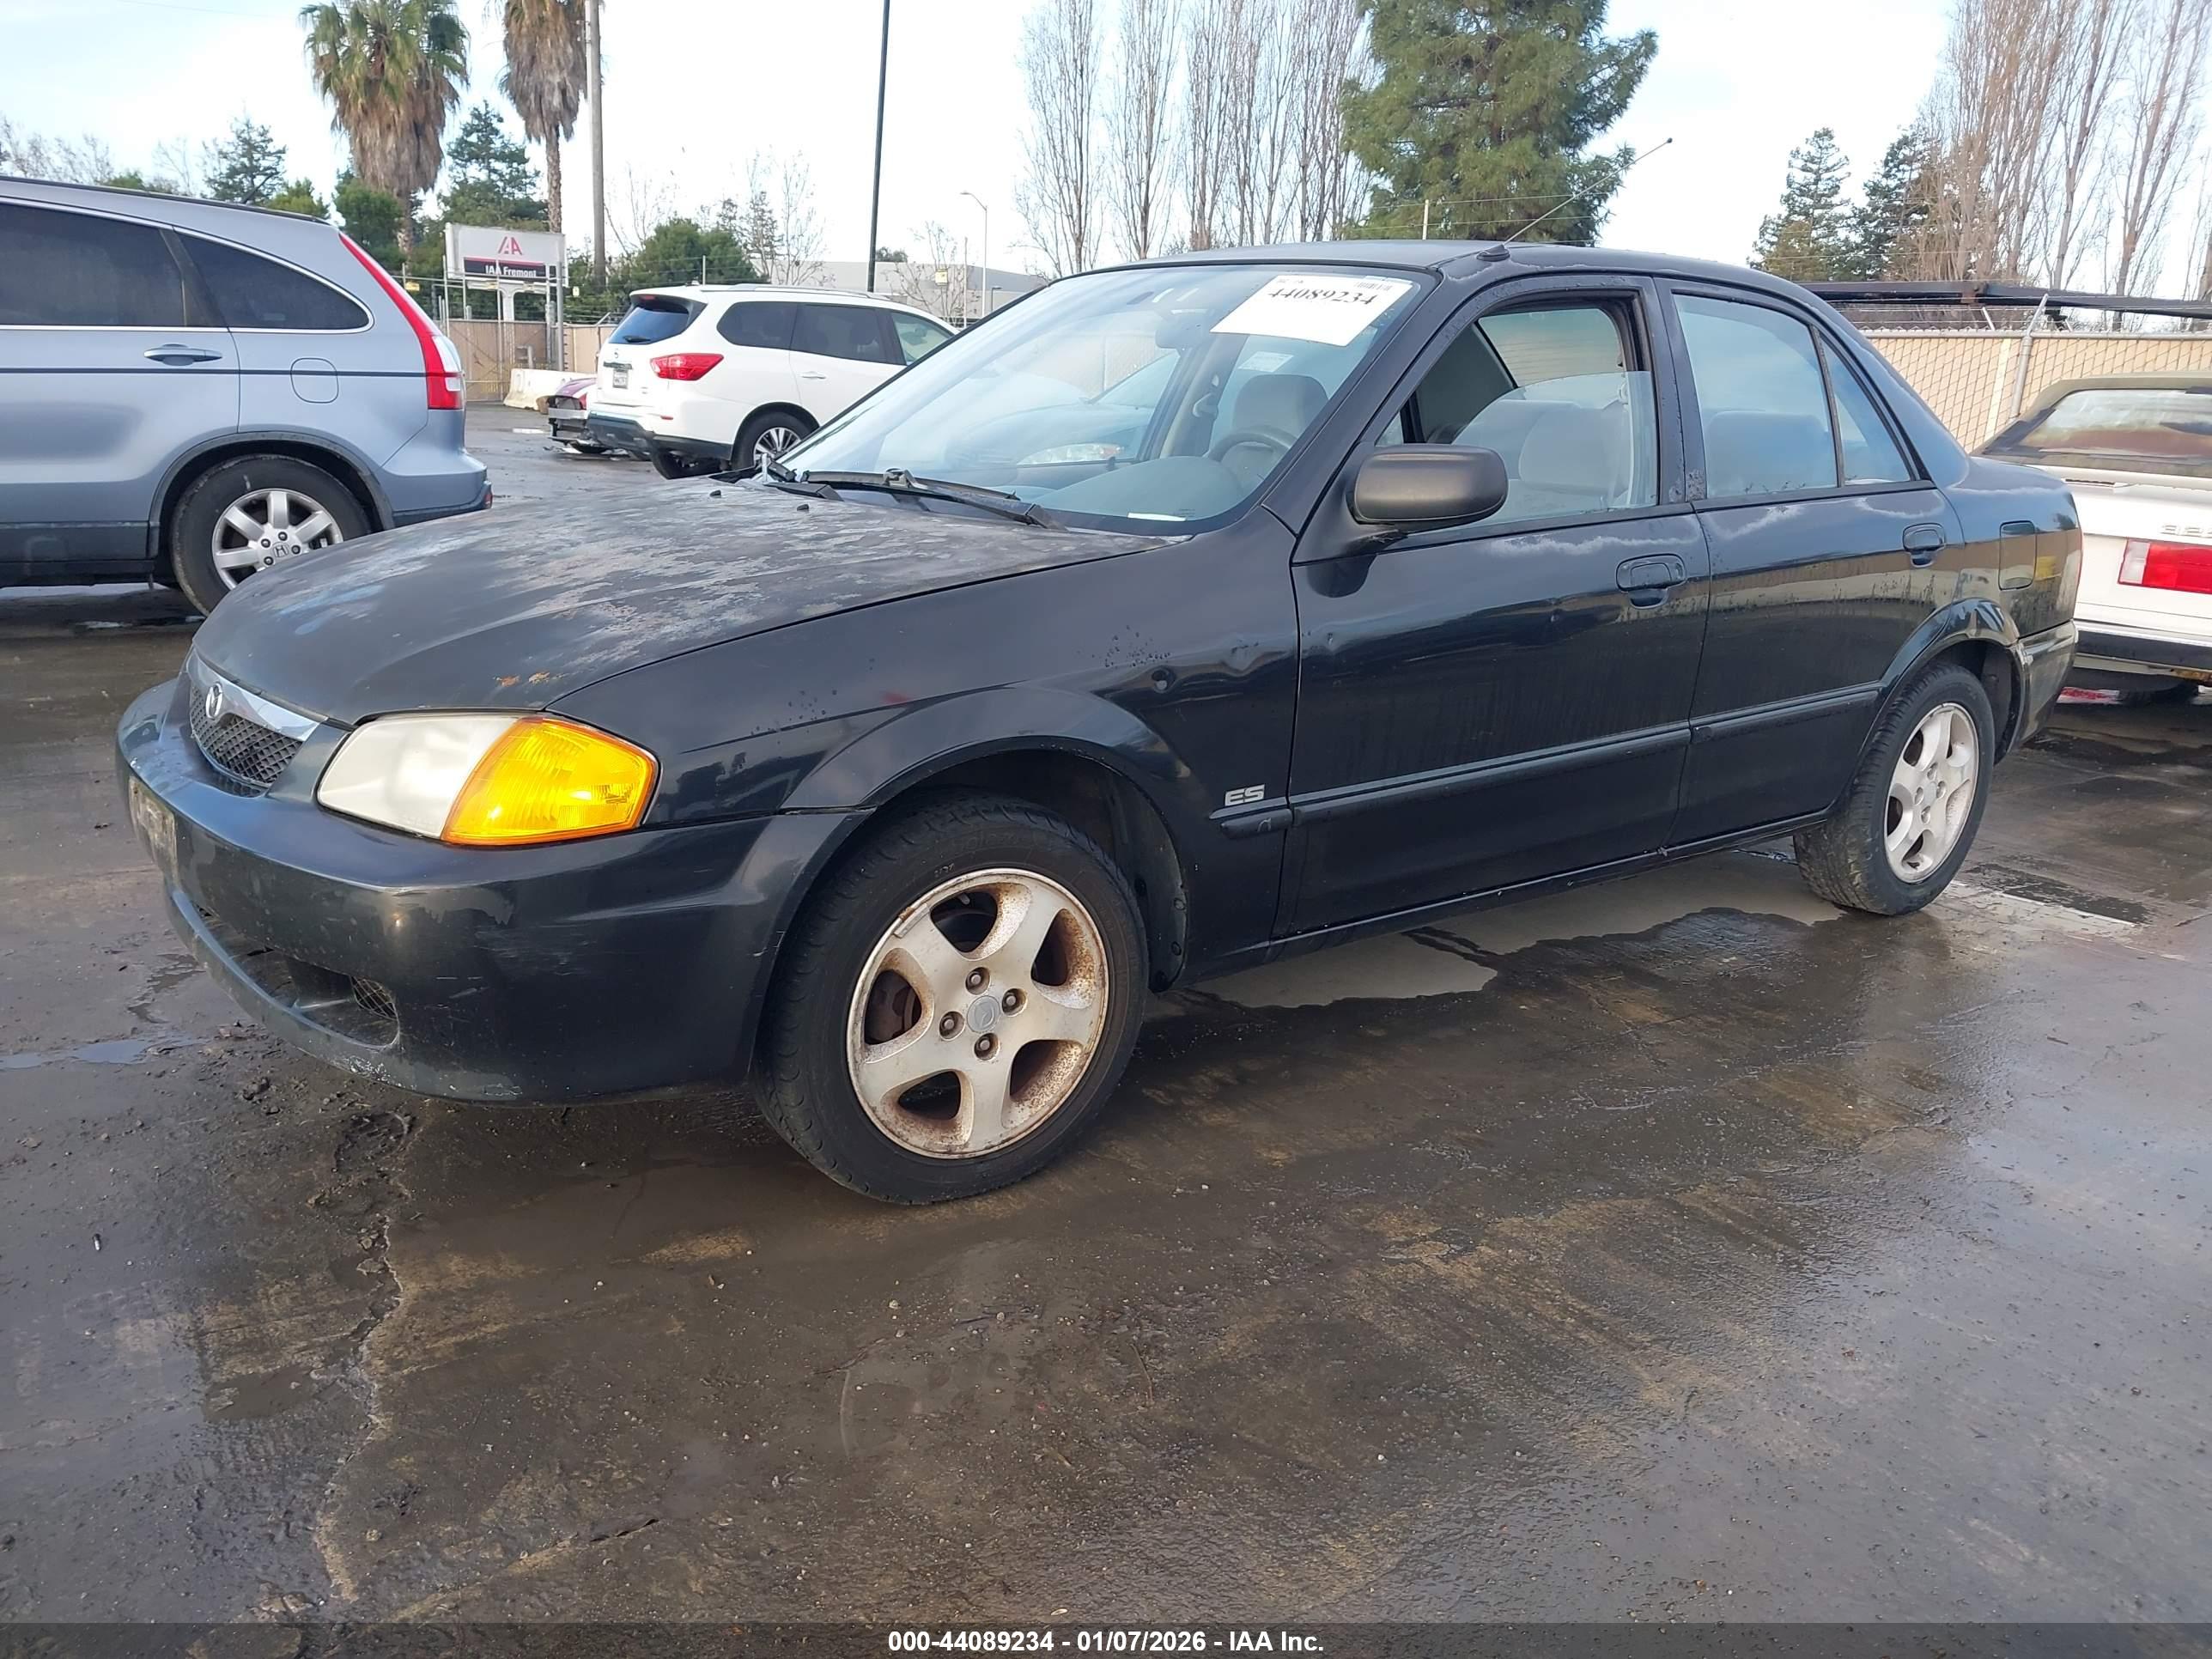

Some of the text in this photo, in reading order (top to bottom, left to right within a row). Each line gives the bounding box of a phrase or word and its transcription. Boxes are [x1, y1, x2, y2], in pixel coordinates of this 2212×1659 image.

[485, 264, 537, 277] IAA Fremont
[1268, 288, 1377, 305] 44089234
[1224, 784, 1265, 806] ES
